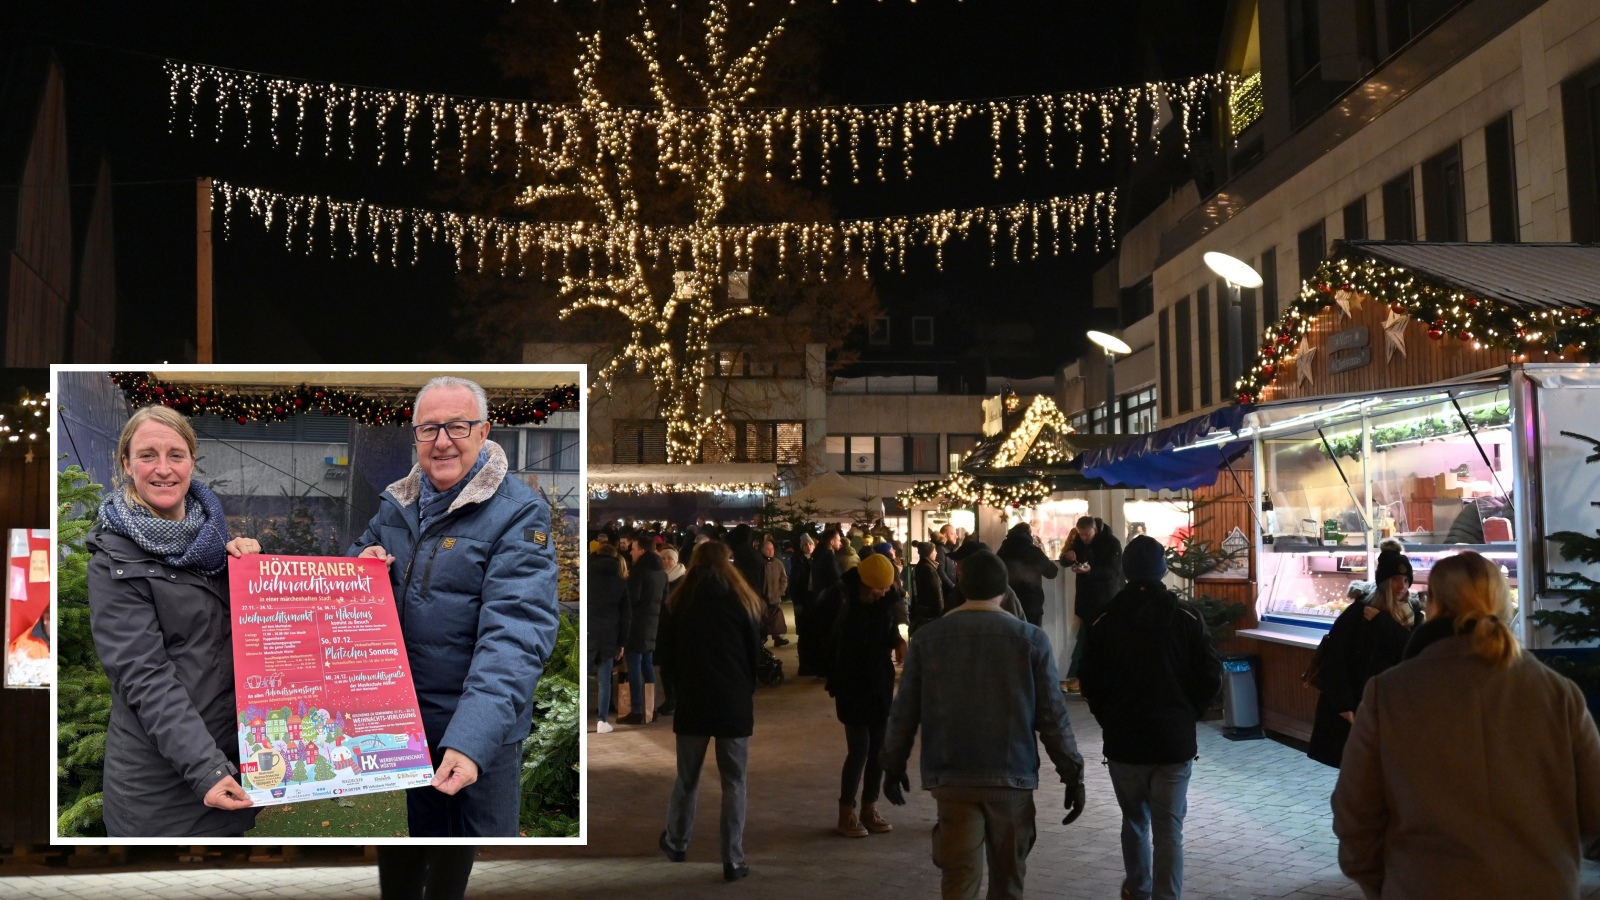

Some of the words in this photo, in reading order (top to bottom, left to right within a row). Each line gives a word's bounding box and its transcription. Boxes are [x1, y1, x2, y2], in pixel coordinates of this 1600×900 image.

[260, 558, 356, 576] HÖXTERANER
[249, 575, 373, 595] Weihnachtsmarkt
[239, 610, 313, 624] Weihnachtsmarkt
[336, 606, 372, 621] Nikolaus
[332, 636, 353, 644] 07.12.
[368, 648, 399, 656] Sonntag
[361, 754, 379, 771] HX
